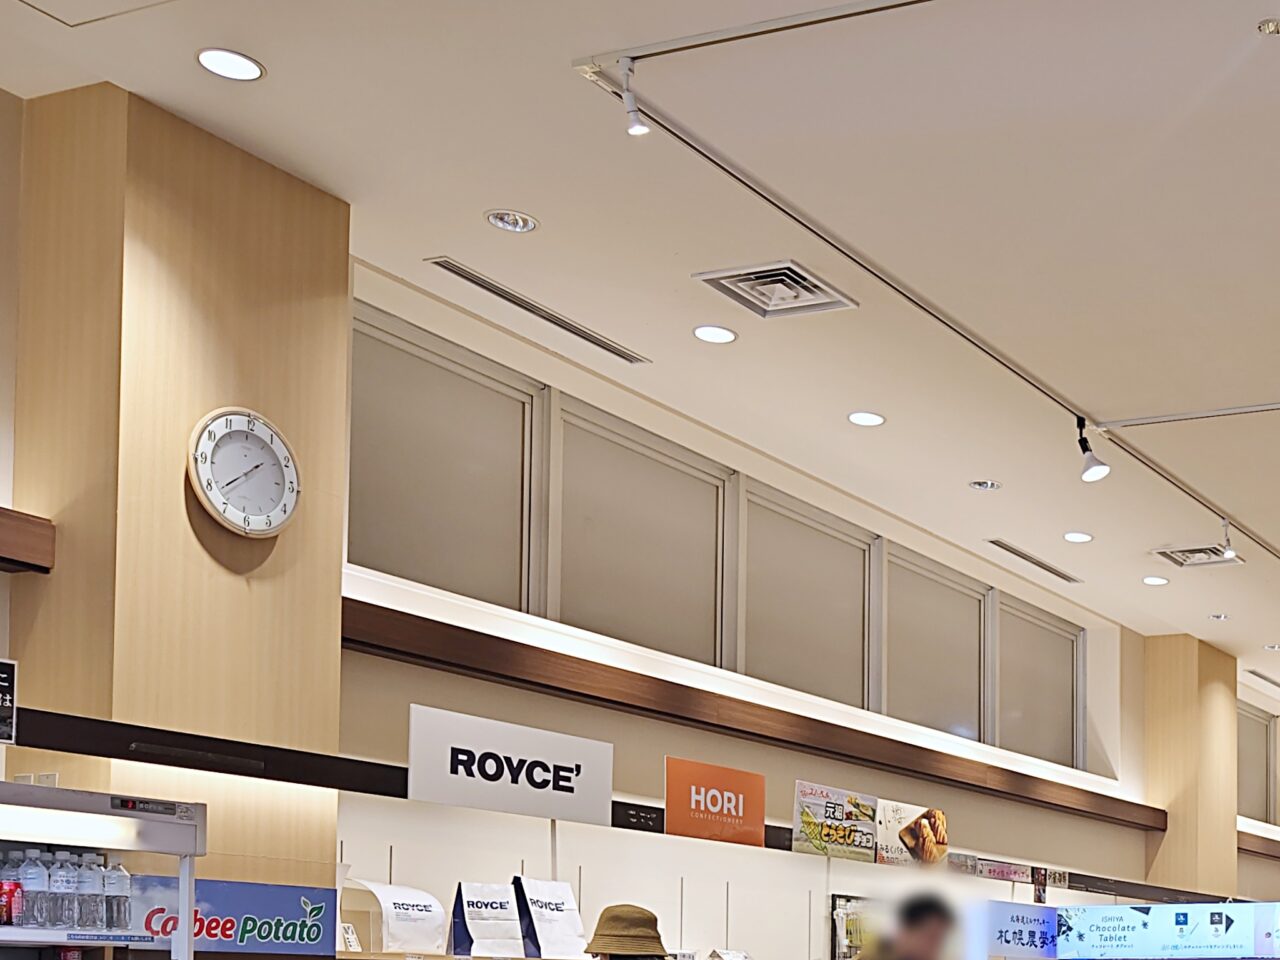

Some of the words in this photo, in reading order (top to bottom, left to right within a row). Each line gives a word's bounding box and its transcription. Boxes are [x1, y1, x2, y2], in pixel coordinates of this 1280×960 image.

[225, 418, 232, 430] 11
[248, 420, 255, 432] 12
[208, 430, 216, 442] 10
[270, 434, 274, 445] 1
[200, 451, 207, 464] 9
[284, 456, 290, 468] 2
[206, 478, 212, 492] 8
[288, 481, 295, 494] 3
[222, 502, 228, 514] 7
[281, 503, 287, 515] 4
[244, 515, 250, 527] 6
[265, 515, 272, 527] 5
[449, 746, 582, 794] ROYCE'
[690, 785, 744, 817] HORI
[824, 801, 845, 821] 元祖
[690, 811, 744, 826] CONFECTIONERY
[145, 907, 236, 939] Cabee
[1089, 924, 1137, 932] Chocolate
[1098, 934, 1127, 942] Tablet
